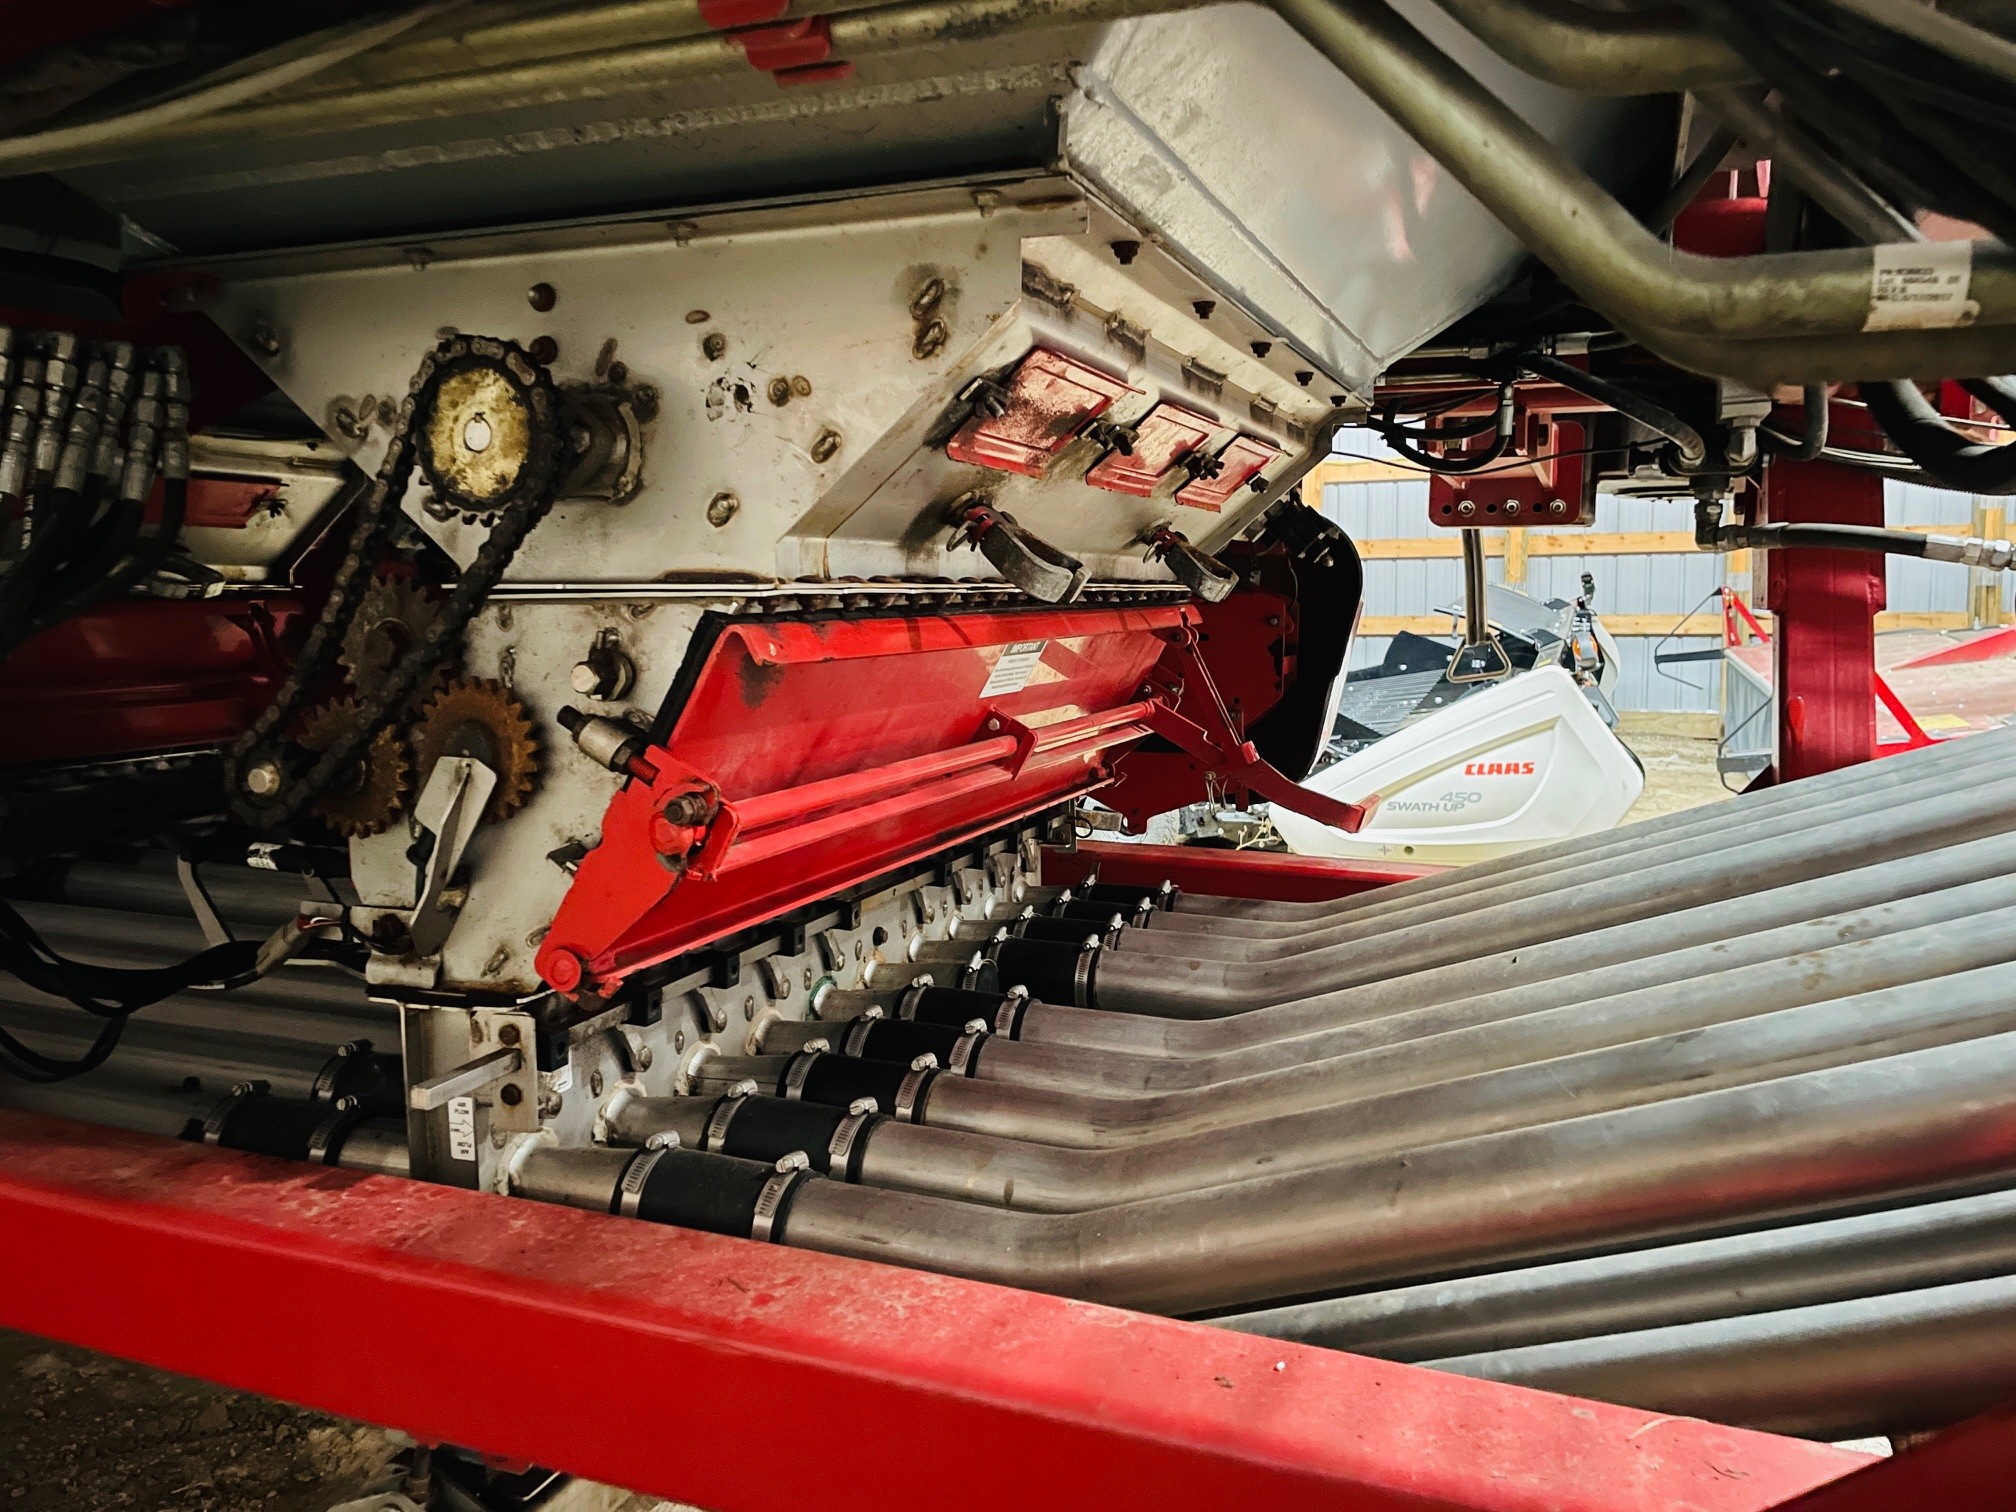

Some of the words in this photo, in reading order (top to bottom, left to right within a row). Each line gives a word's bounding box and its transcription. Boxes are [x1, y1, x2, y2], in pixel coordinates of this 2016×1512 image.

[1464, 762, 1535, 776] CLAAS
[1440, 791, 1483, 804] 450
[1387, 801, 1440, 812] SWATH
[1443, 802, 1465, 813] UP
